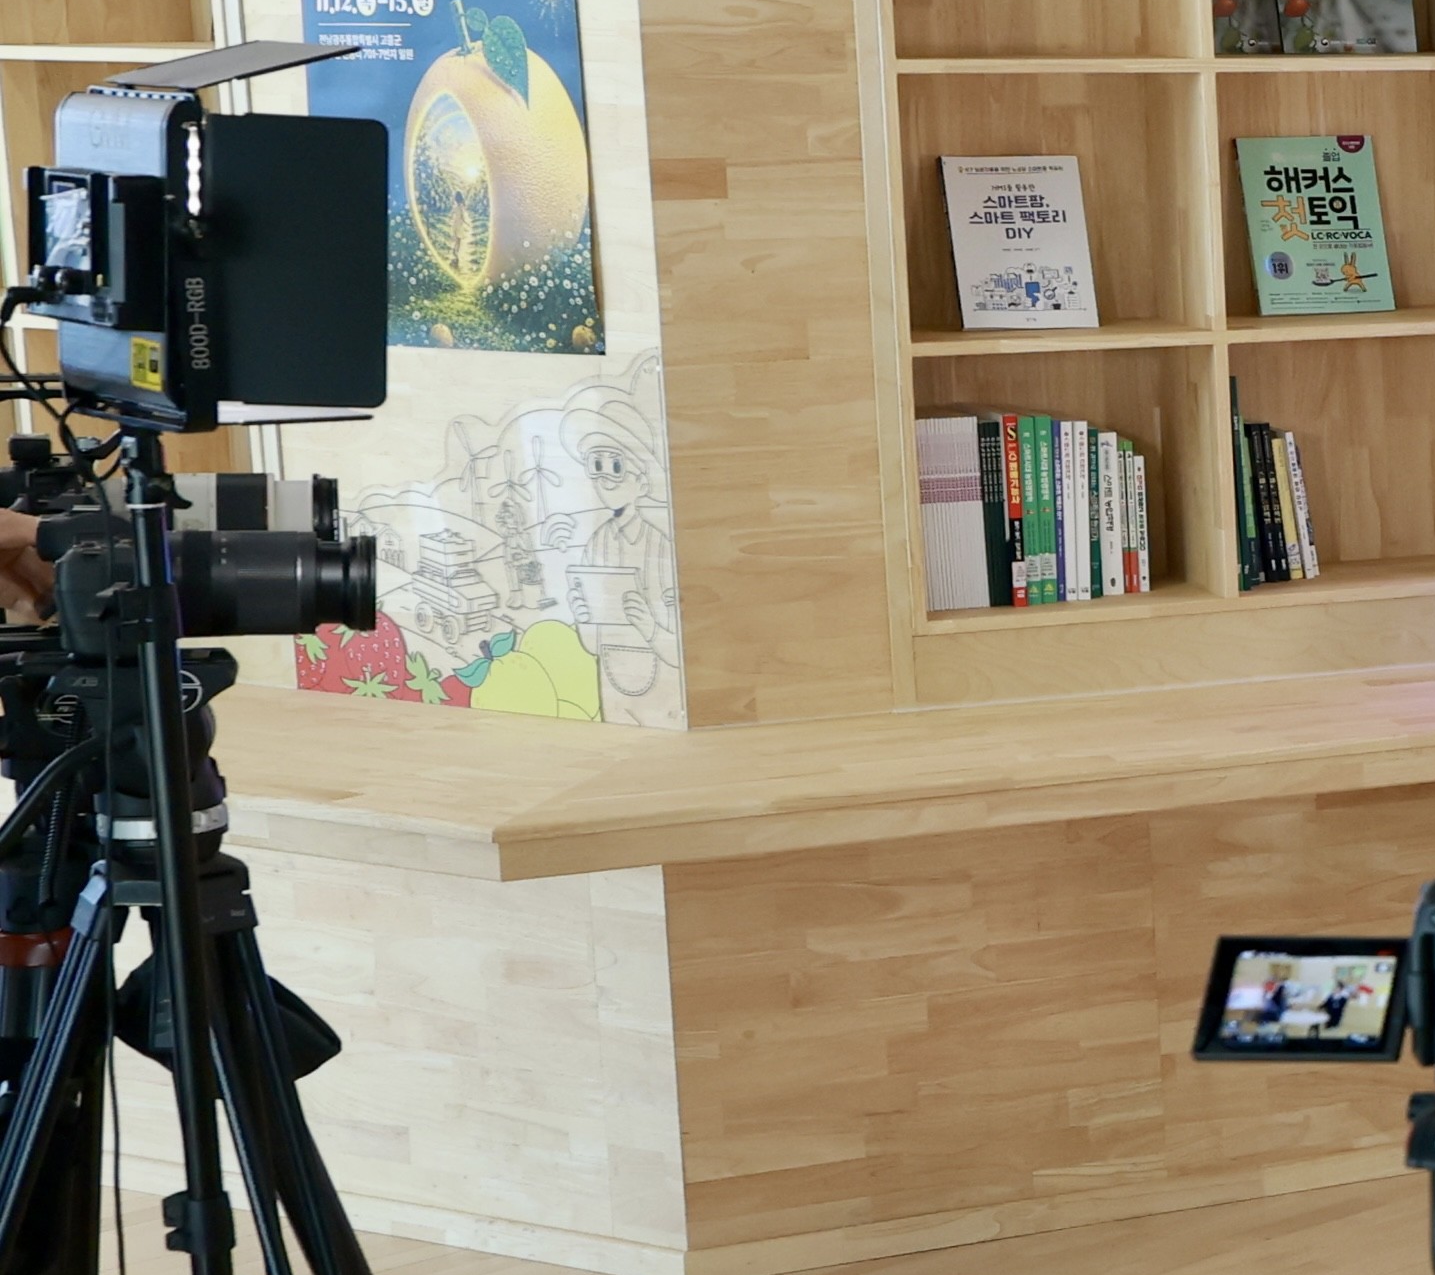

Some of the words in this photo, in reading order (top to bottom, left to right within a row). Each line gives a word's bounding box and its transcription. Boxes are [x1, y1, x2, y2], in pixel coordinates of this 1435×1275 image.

[380, 33, 402, 46] 고흥군
[398, 48, 414, 61] 일원
[1264, 165, 1355, 193] 해커스
[983, 195, 1050, 209] 스마트팜,
[969, 210, 1016, 224] 스마트
[1020, 210, 1067, 223] 팩토리
[1005, 227, 1034, 239] DIY
[1272, 263, 1289, 274] 1위
[185, 277, 210, 370] 800D-RGB
